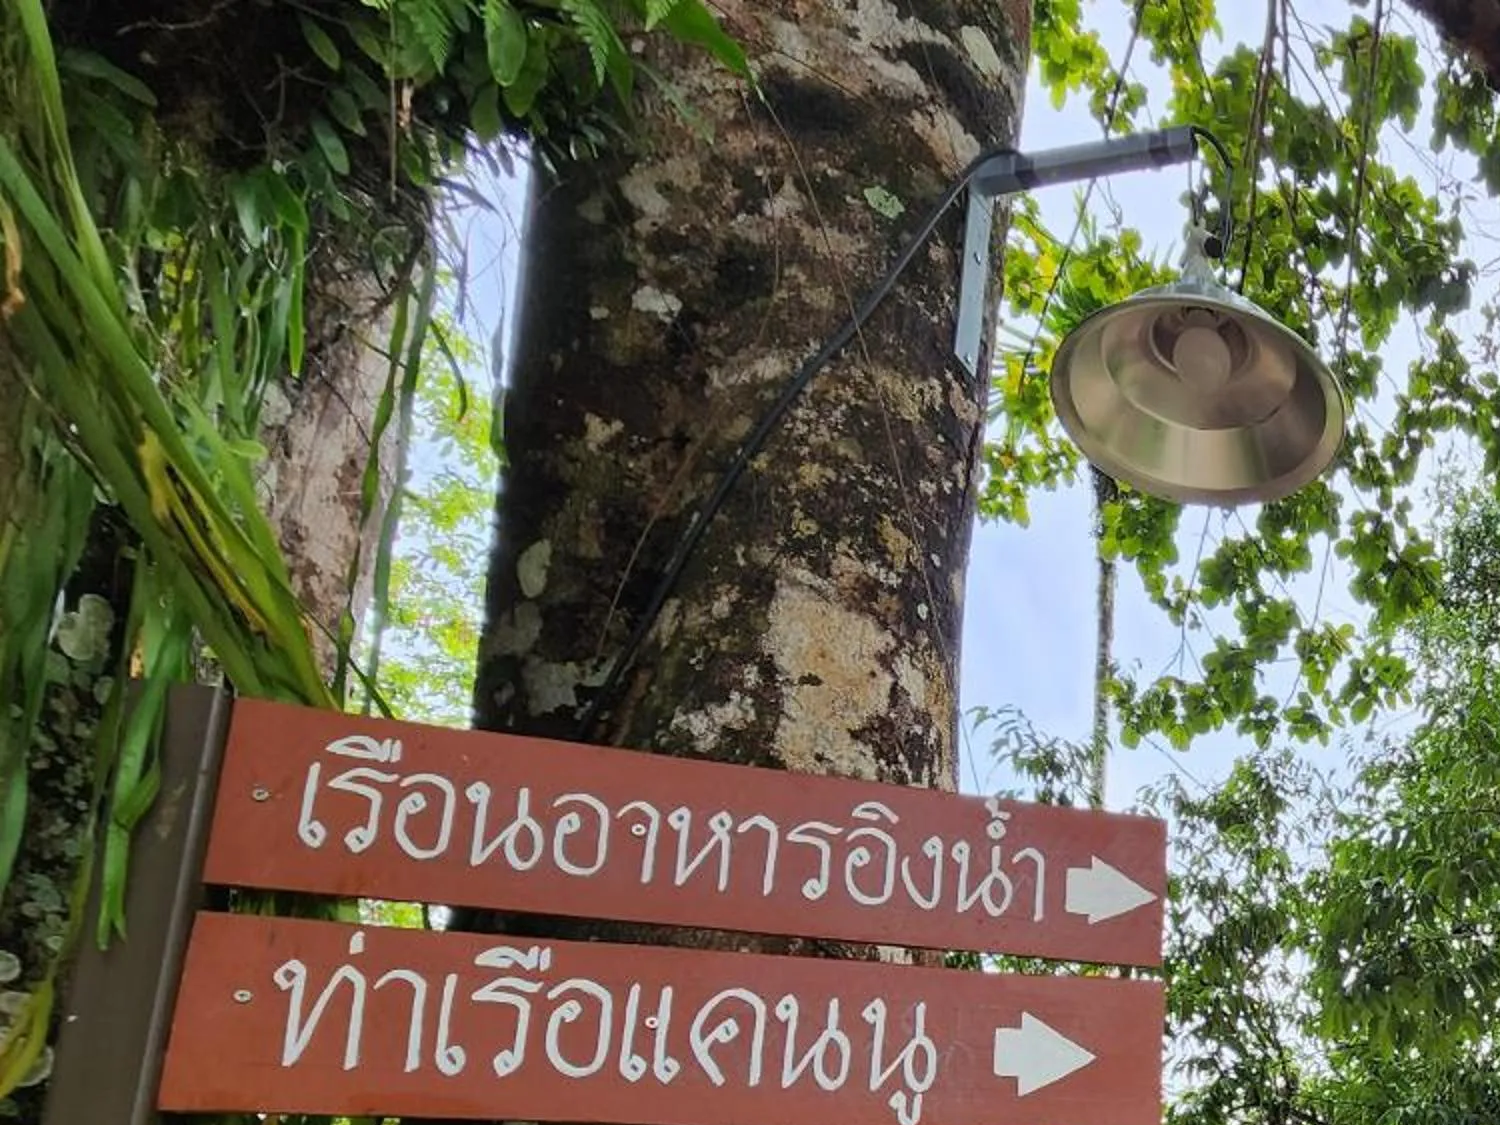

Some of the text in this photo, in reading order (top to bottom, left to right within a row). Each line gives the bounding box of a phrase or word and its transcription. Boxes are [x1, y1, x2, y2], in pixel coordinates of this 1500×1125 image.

[297, 734, 1047, 923] เรือนอาหารอิงน้ำ
